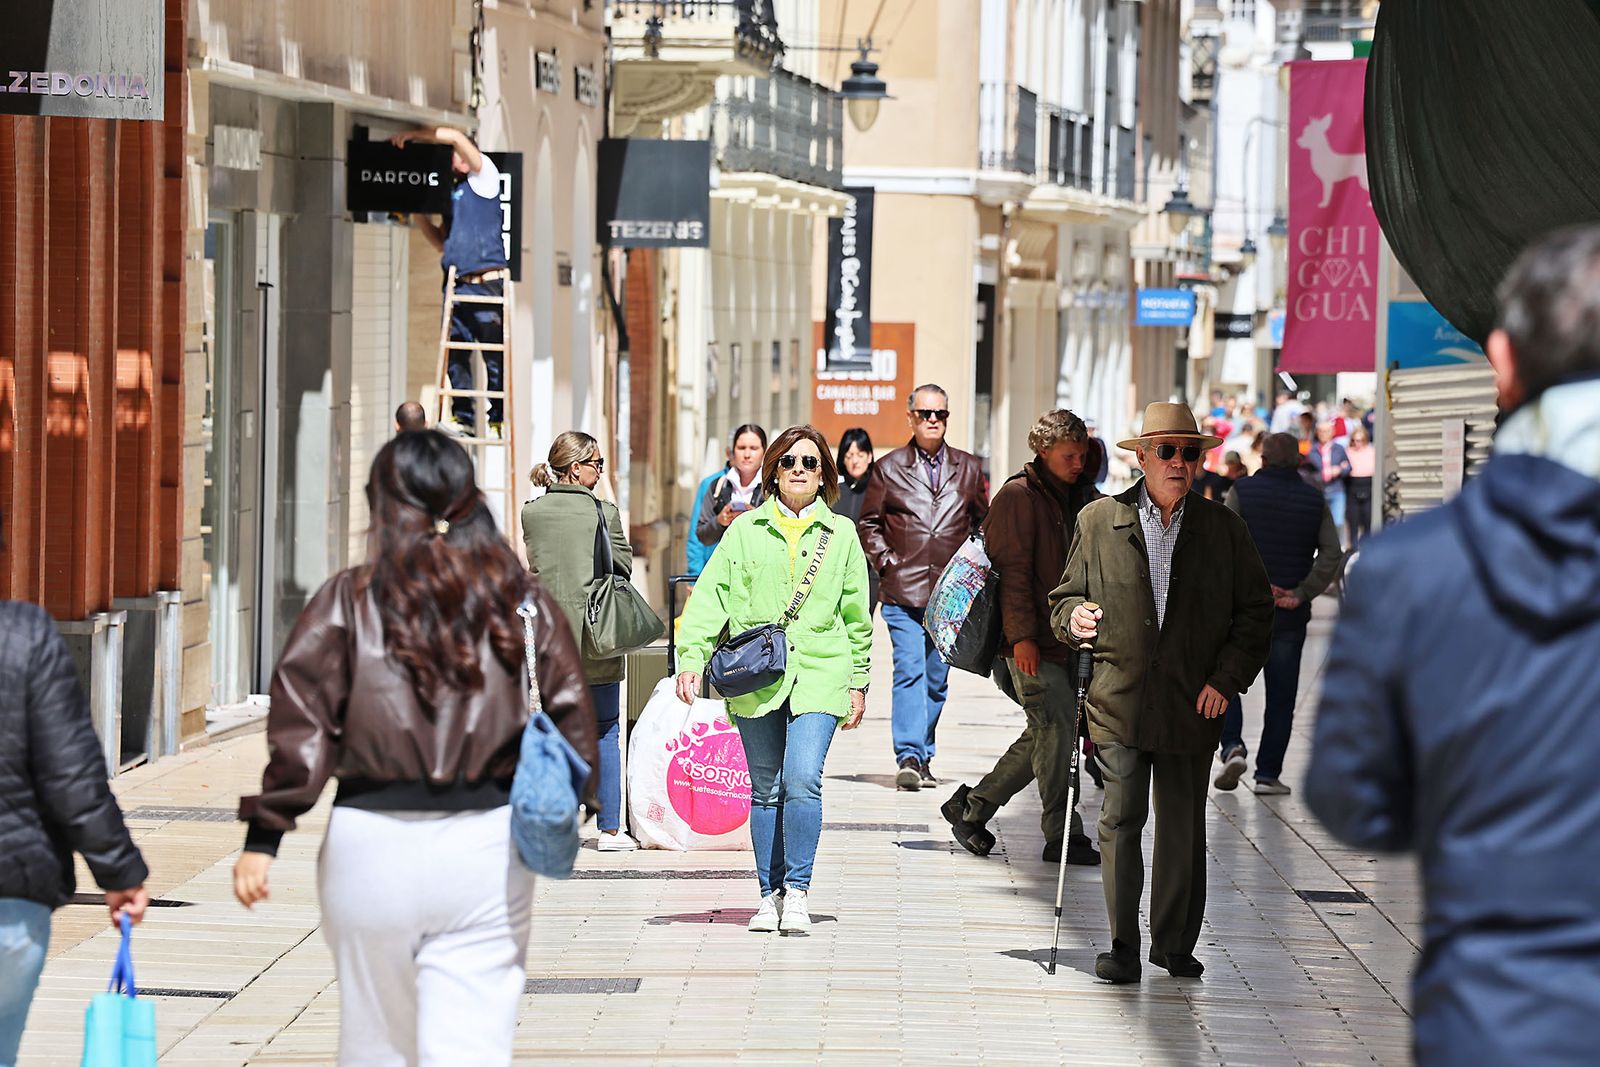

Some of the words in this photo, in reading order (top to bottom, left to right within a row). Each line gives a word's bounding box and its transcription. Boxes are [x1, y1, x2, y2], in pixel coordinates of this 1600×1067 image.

[608, 220, 703, 240] TEZENIS
[1298, 226, 1367, 257] CHI
[1295, 293, 1370, 321] GUA
[872, 385, 896, 401] BAR
